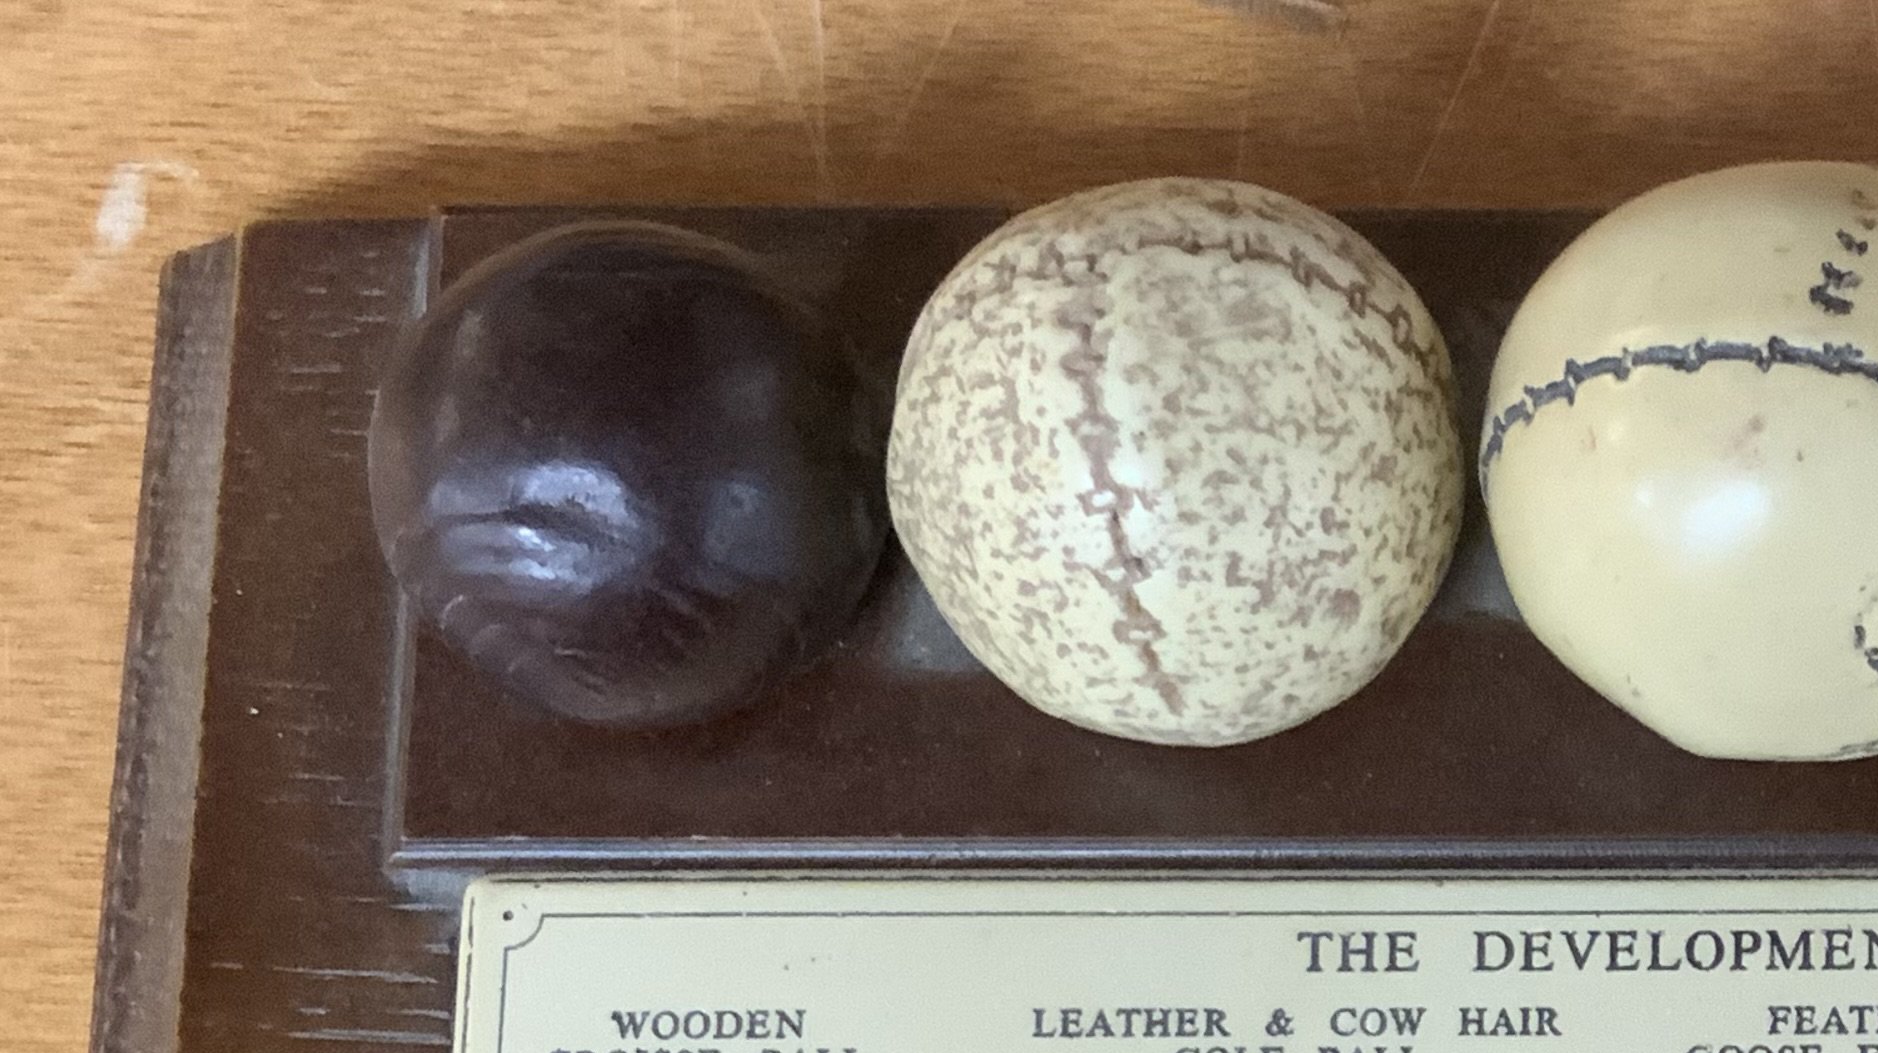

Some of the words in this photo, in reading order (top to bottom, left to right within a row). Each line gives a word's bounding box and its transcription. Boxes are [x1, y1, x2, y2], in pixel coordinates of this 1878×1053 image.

[1296, 930, 1420, 973] THE
[610, 1009, 807, 1041] WOODEN
[1031, 1007, 1232, 1040] LEATHER
[1264, 1007, 1295, 1038] &
[1329, 1006, 1427, 1037] COW
[1457, 1006, 1563, 1037] HAIR
